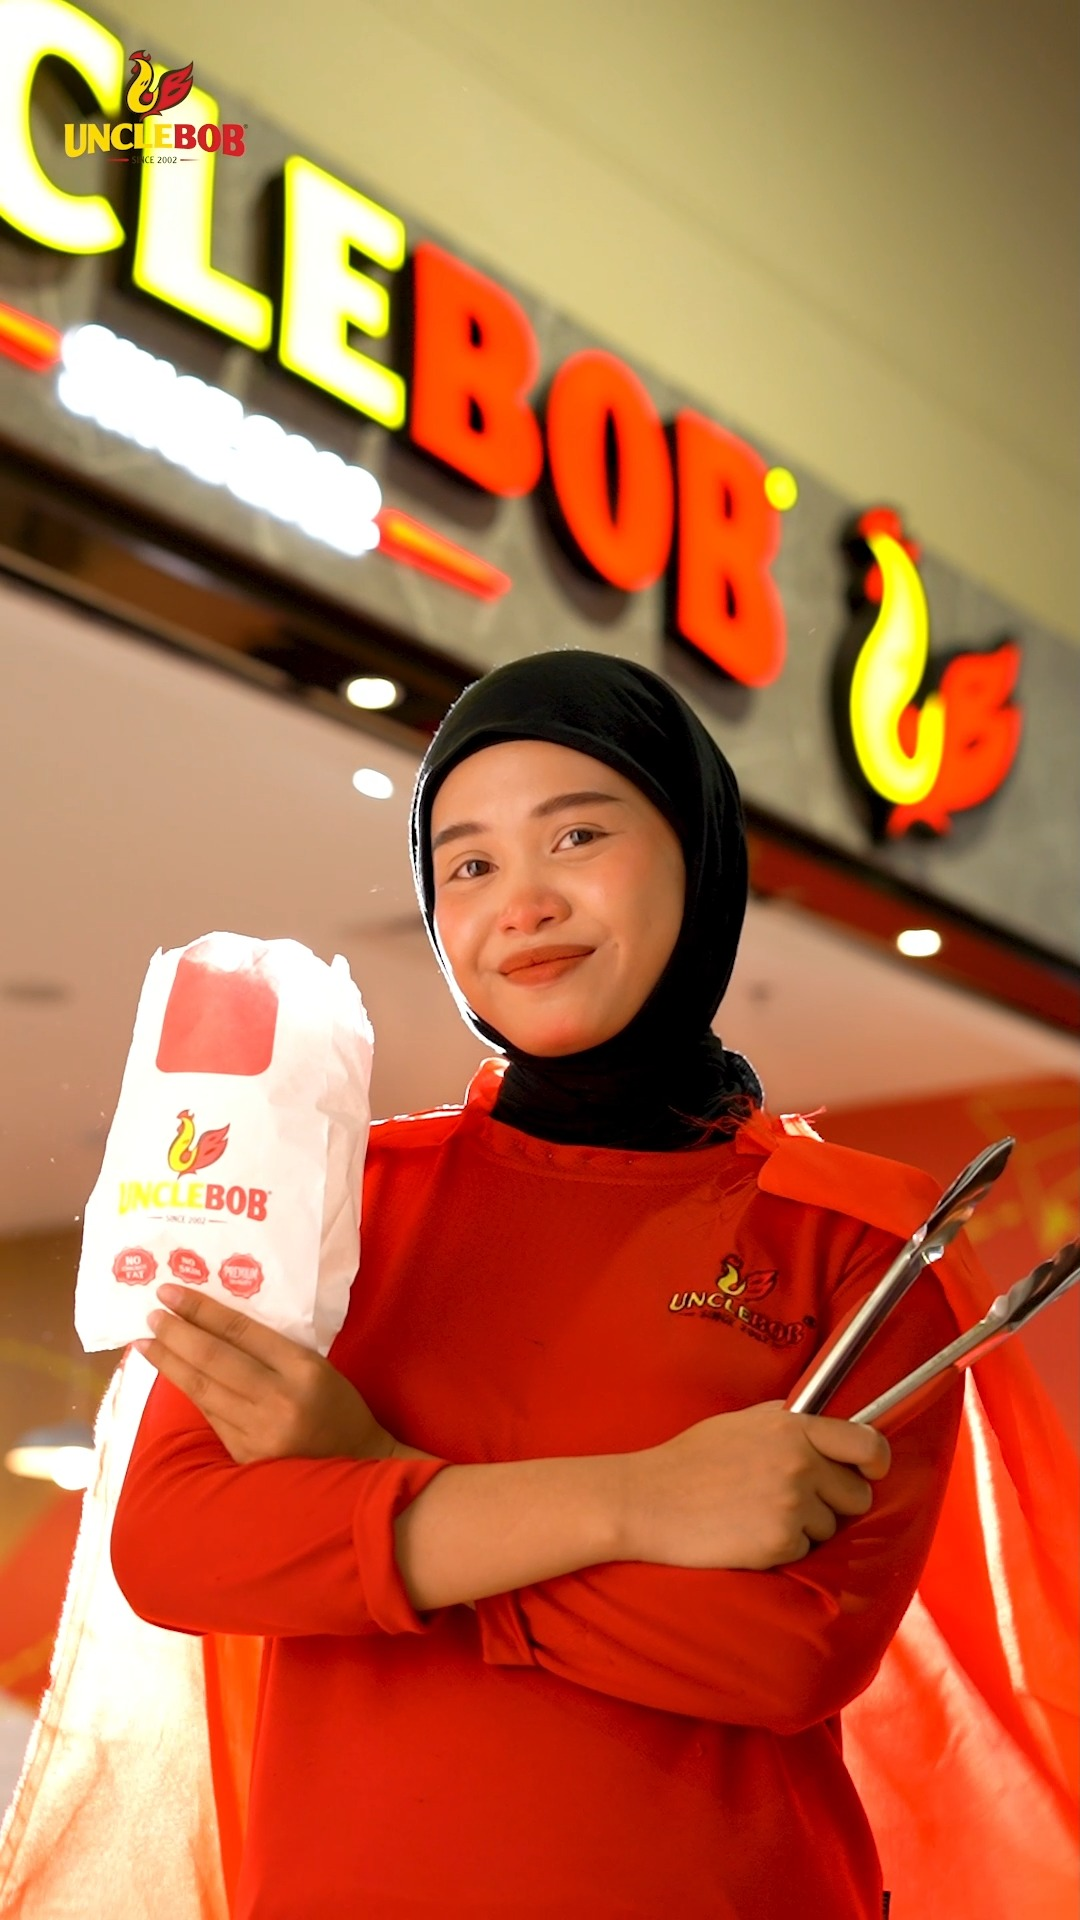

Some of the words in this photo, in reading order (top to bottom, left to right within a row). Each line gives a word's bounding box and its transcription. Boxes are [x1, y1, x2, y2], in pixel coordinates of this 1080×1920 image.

[166, 1215, 185, 1224] SINCE
[125, 1255, 141, 1265] NO
[181, 1256, 196, 1267] NO
[126, 1271, 145, 1280] FAT
